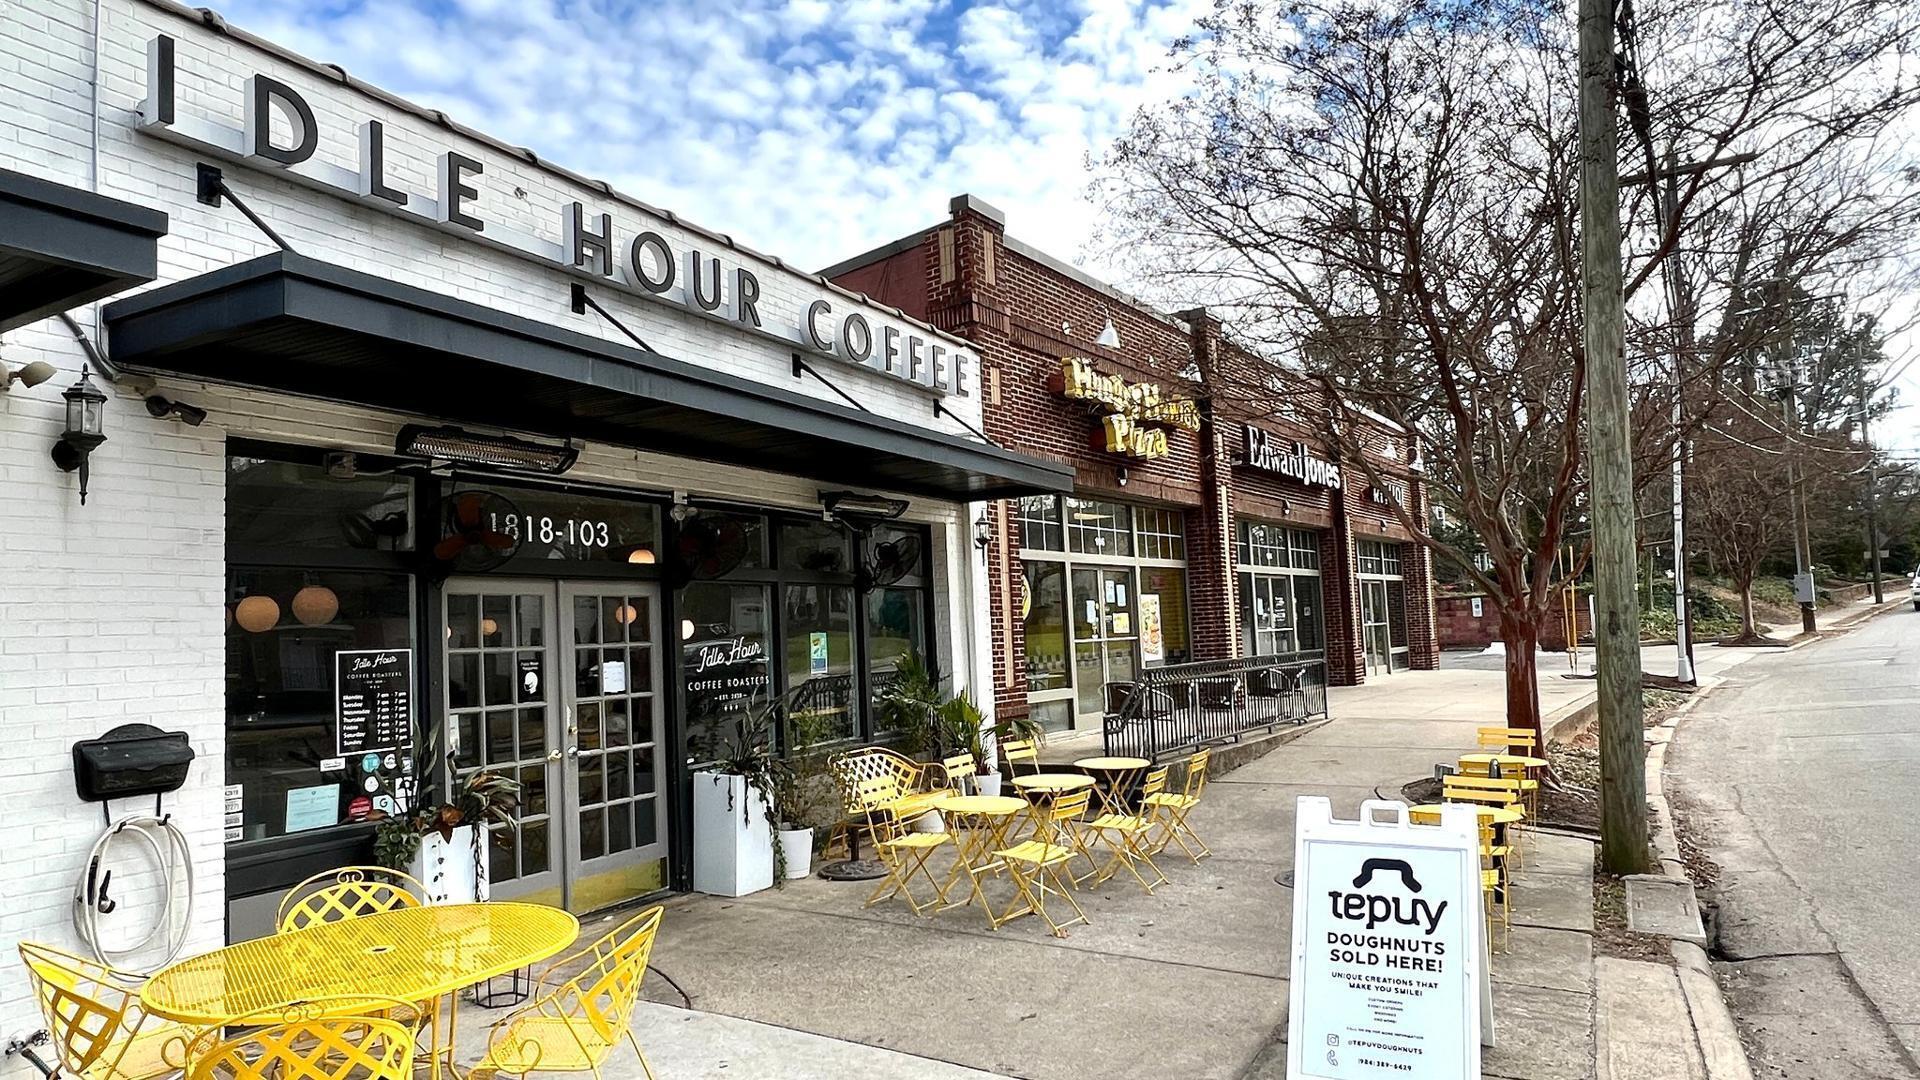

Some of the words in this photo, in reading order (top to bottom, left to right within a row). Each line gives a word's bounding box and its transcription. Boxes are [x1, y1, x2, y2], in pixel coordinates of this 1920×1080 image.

[156, 33, 485, 232] IDLE
[572, 201, 762, 328] HOUR
[807, 300, 969, 398] COFFEE
[1108, 414, 1169, 460] Pizza
[1246, 425, 1303, 479] Edward
[1303, 444, 1341, 490] Jones
[490, 512, 609, 547] 1818-103
[696, 646, 725, 673] Idle
[725, 636, 762, 665] Hour
[687, 679, 722, 692] COFFEE
[727, 675, 769, 687] ROASTERS
[1328, 890, 1447, 935] tepuy
[1327, 931, 1445, 955] DOUGHNUTS
[1330, 949, 1379, 965] SOLD
[1386, 954, 1442, 973] HERE!
[1331, 971, 1362, 981] UNIQUE
[1365, 975, 1413, 986] CREATIONS
[1416, 980, 1438, 989] THAT
[1349, 982, 1371, 990] MAKE
[1395, 987, 1422, 996] SMILE!
